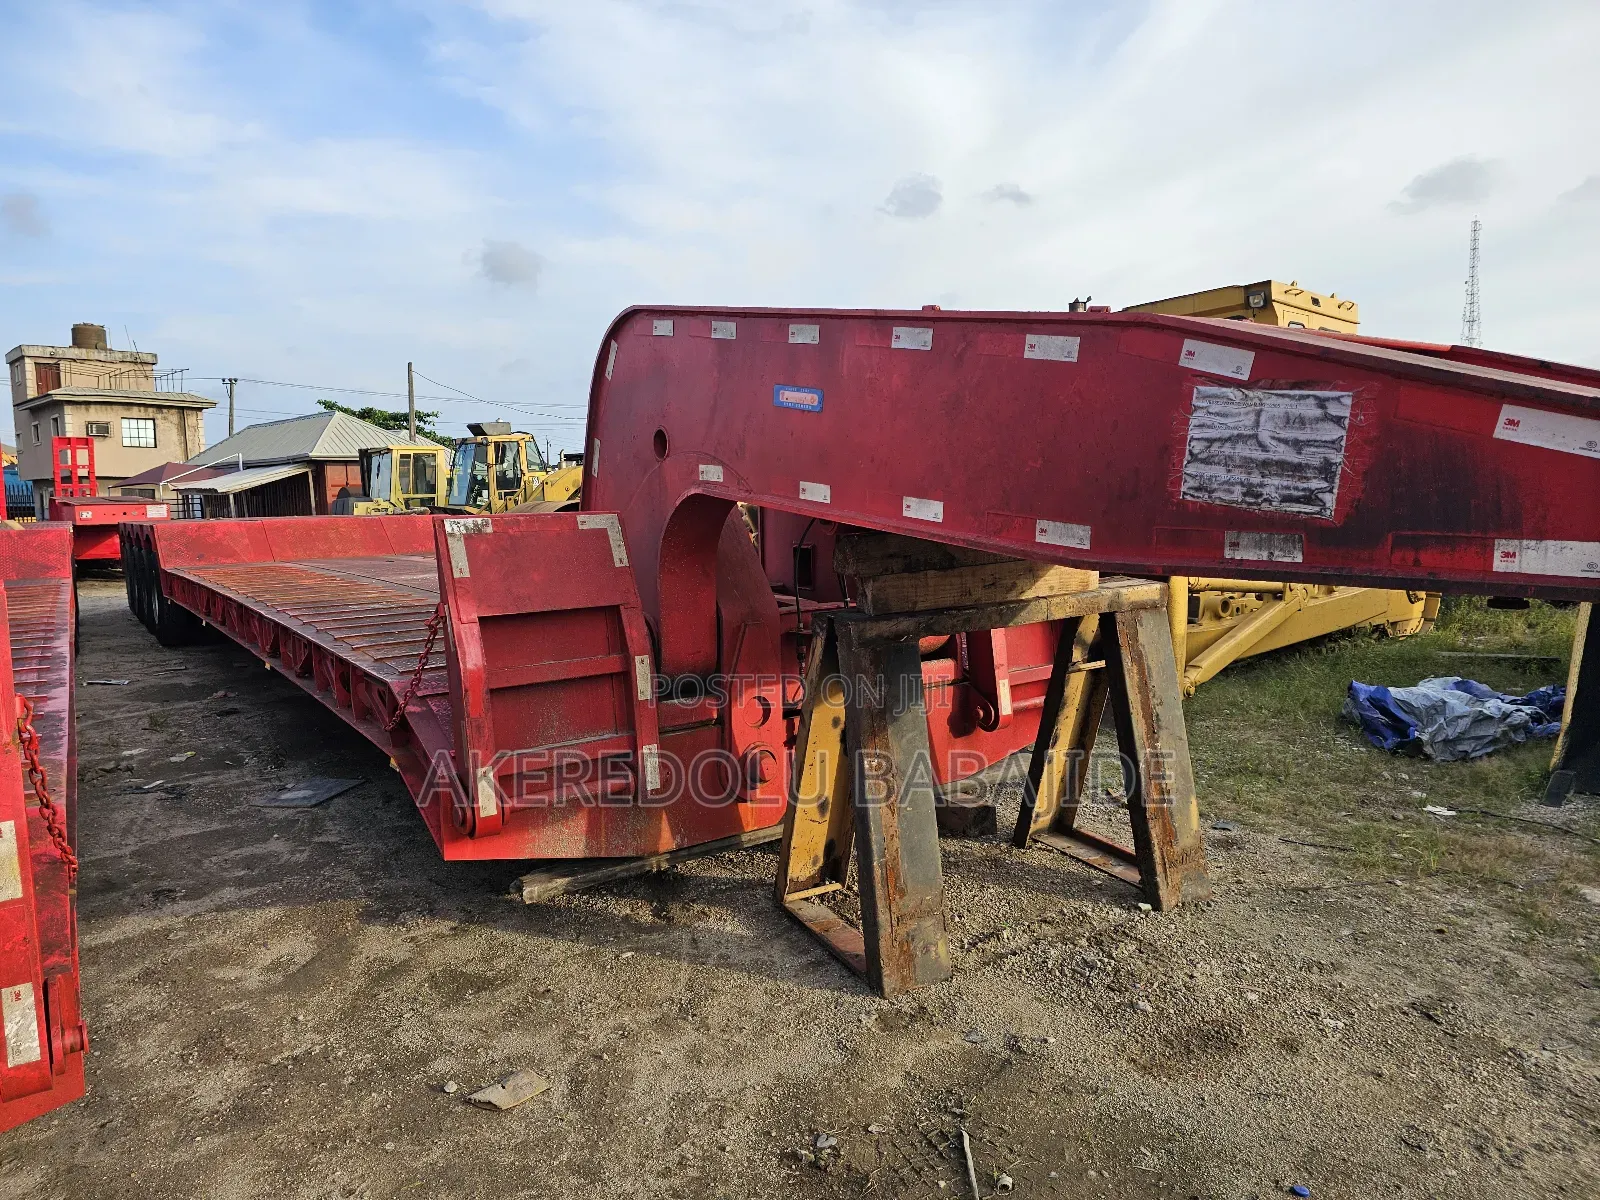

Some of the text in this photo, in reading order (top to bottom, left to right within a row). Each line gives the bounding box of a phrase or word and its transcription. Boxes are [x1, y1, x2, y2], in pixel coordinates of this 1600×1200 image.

[1184, 349, 1196, 358] 3M
[1503, 418, 1520, 428] 3M
[1500, 550, 1517, 559] 3M
[14, 990, 22, 1002] 3M
